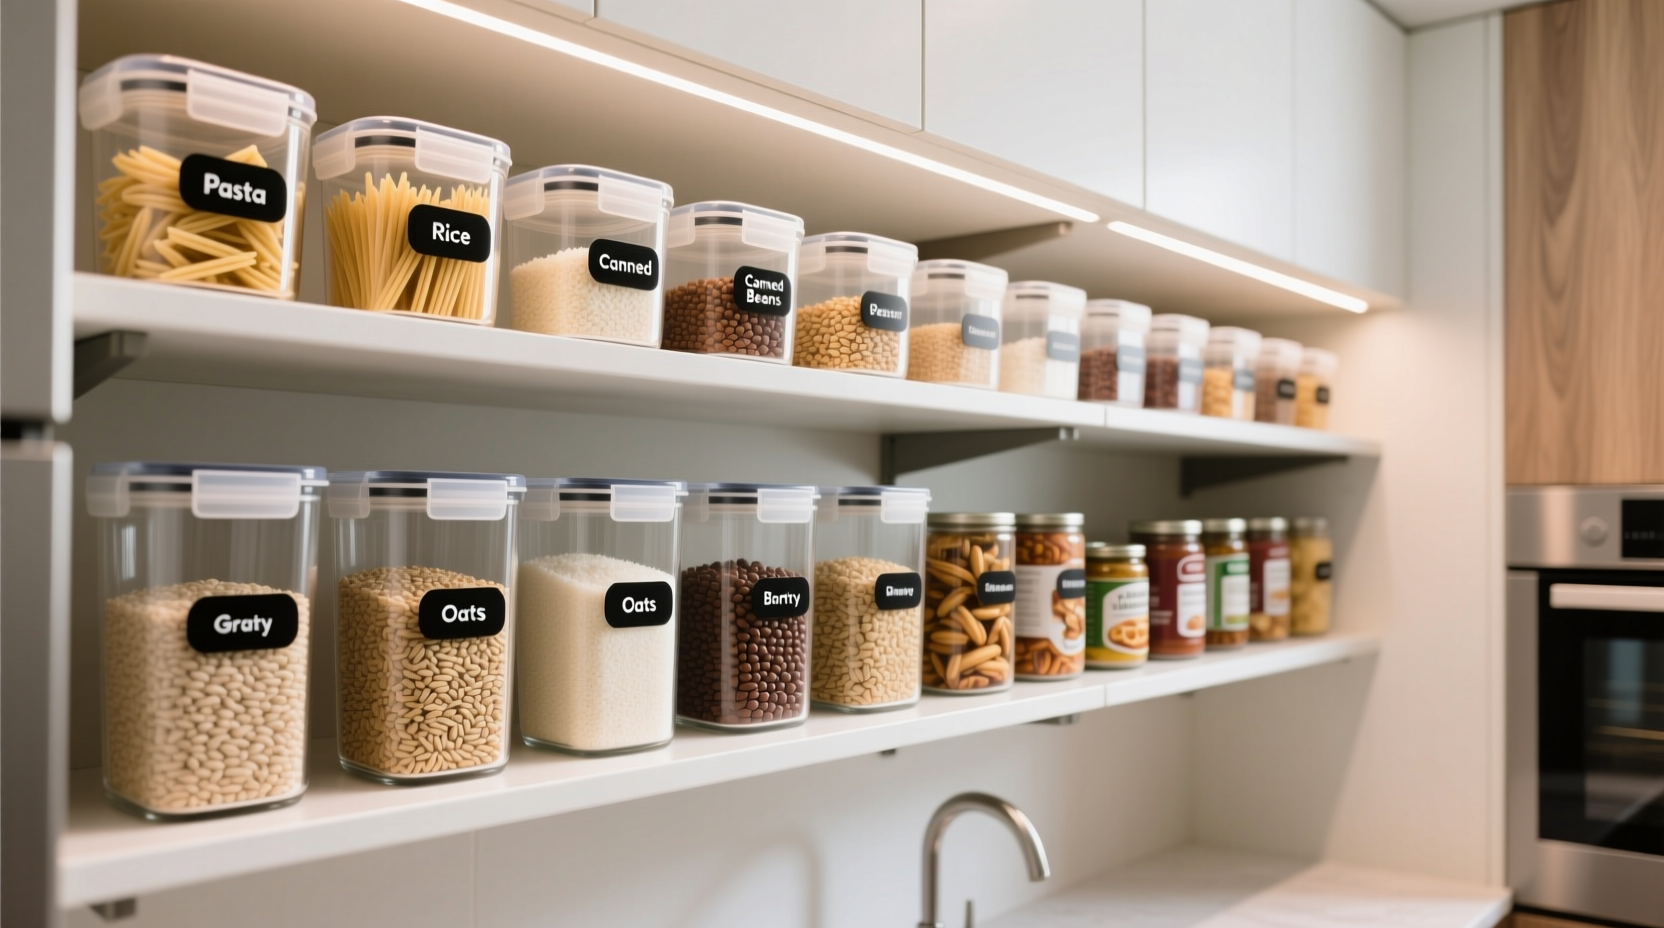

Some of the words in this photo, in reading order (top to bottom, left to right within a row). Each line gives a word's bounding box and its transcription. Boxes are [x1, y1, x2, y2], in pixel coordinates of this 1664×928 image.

[203, 172, 267, 205] Pasta
[432, 221, 471, 246] Rice
[599, 253, 652, 276] Canned
[441, 604, 486, 623] Oats
[622, 597, 657, 614] Oats
[213, 613, 273, 637] Graty
